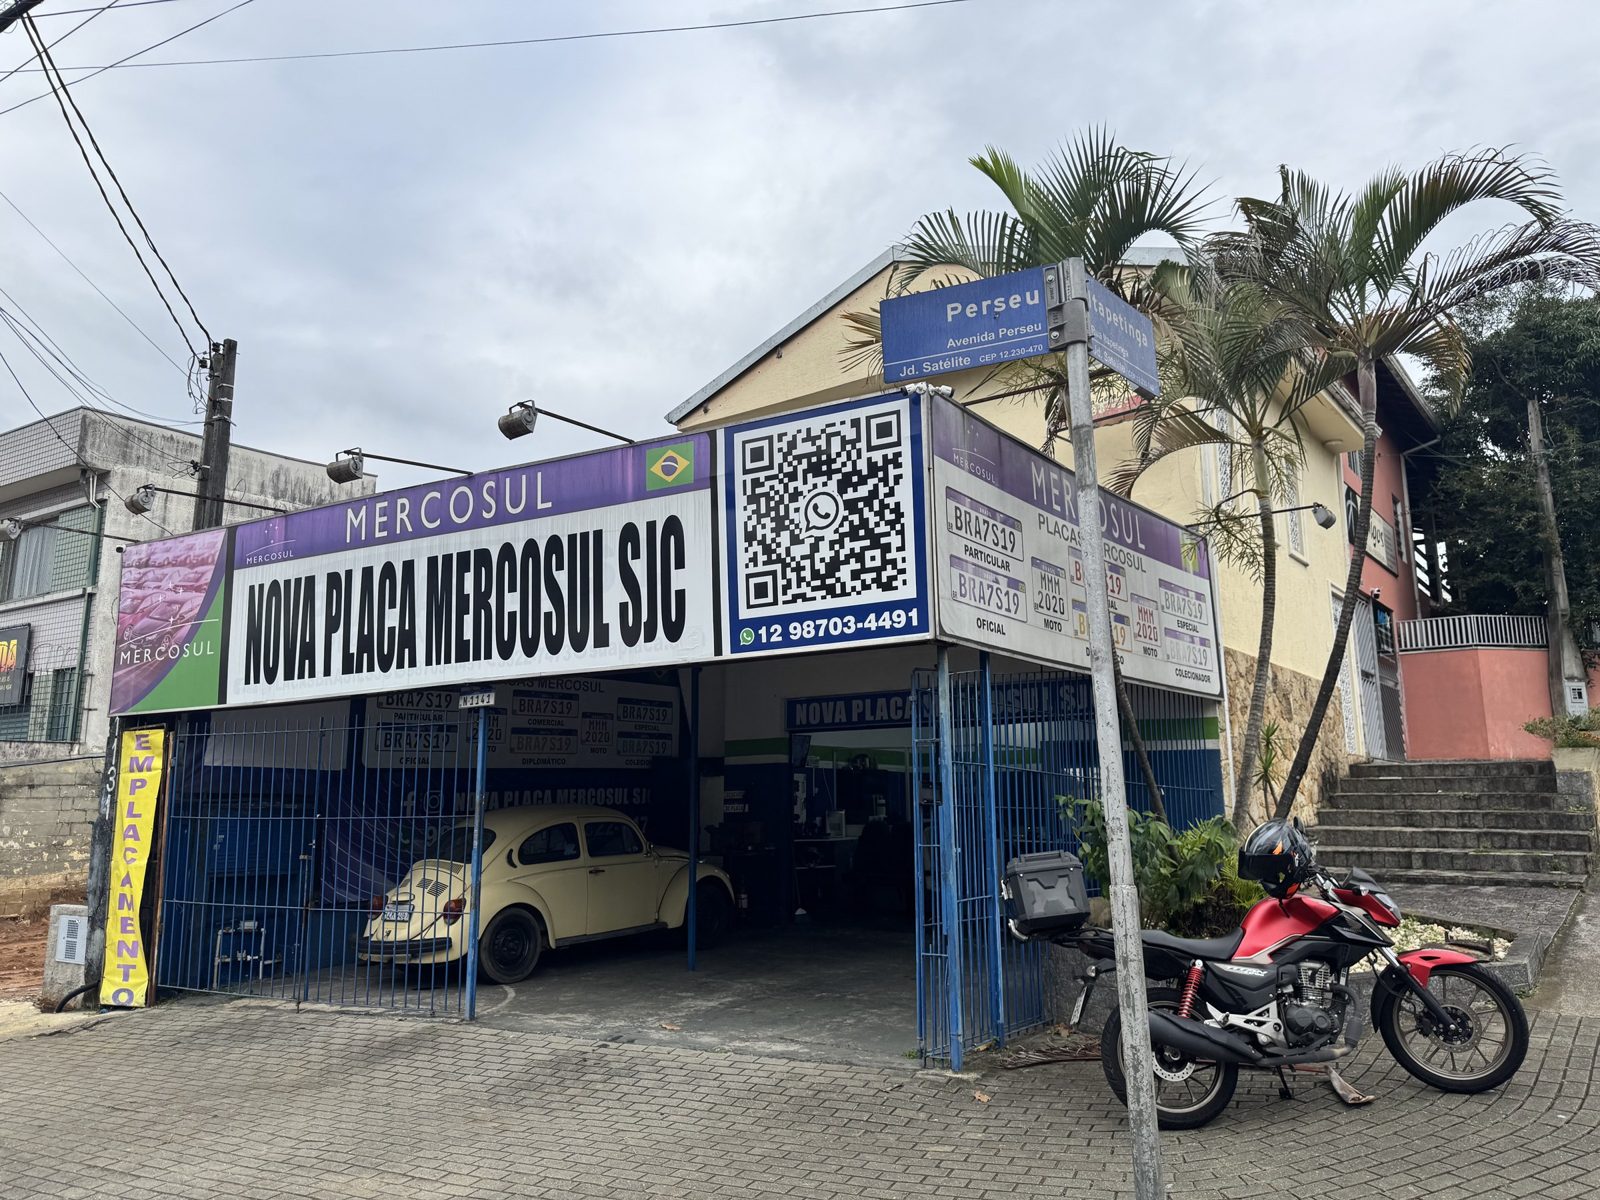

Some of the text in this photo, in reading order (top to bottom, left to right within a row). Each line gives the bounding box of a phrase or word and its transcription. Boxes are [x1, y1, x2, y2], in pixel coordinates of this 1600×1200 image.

[946, 289, 1040, 322] Perseu
[946, 322, 1042, 349] Avenida Perseu
[900, 344, 1043, 377] Jd. Satélite CEP 12.230-470
[953, 453, 996, 485] MERCOSUL
[347, 471, 553, 543] MERCOSUL
[1031, 461, 1146, 551] MEROSUL
[954, 505, 1016, 554] BRA7S19
[246, 550, 294, 565] MERCOSUL
[964, 544, 1011, 572] PARTICULAR
[1103, 543, 1147, 573] RCOSUL
[959, 572, 1020, 616] BRA7S19
[1040, 571, 1060, 596] MMM
[244, 514, 686, 685] NOVA PLACA MERCOSUL SJC
[1037, 590, 1065, 615] 2020
[758, 608, 918, 643] 12 98703-4491
[976, 617, 1006, 636] OFICIAL
[1043, 617, 1063, 633] MOTO
[1136, 620, 1159, 643] 2020
[1176, 619, 1199, 634] ESPECIAL
[119, 641, 215, 666] MERCOSUL
[1142, 646, 1158, 658] MOTO
[538, 679, 605, 693] MERCOSUL
[1175, 667, 1211, 684] COLECIONADOR
[519, 698, 572, 715] BRA7S19
[796, 701, 847, 726] NOVA
